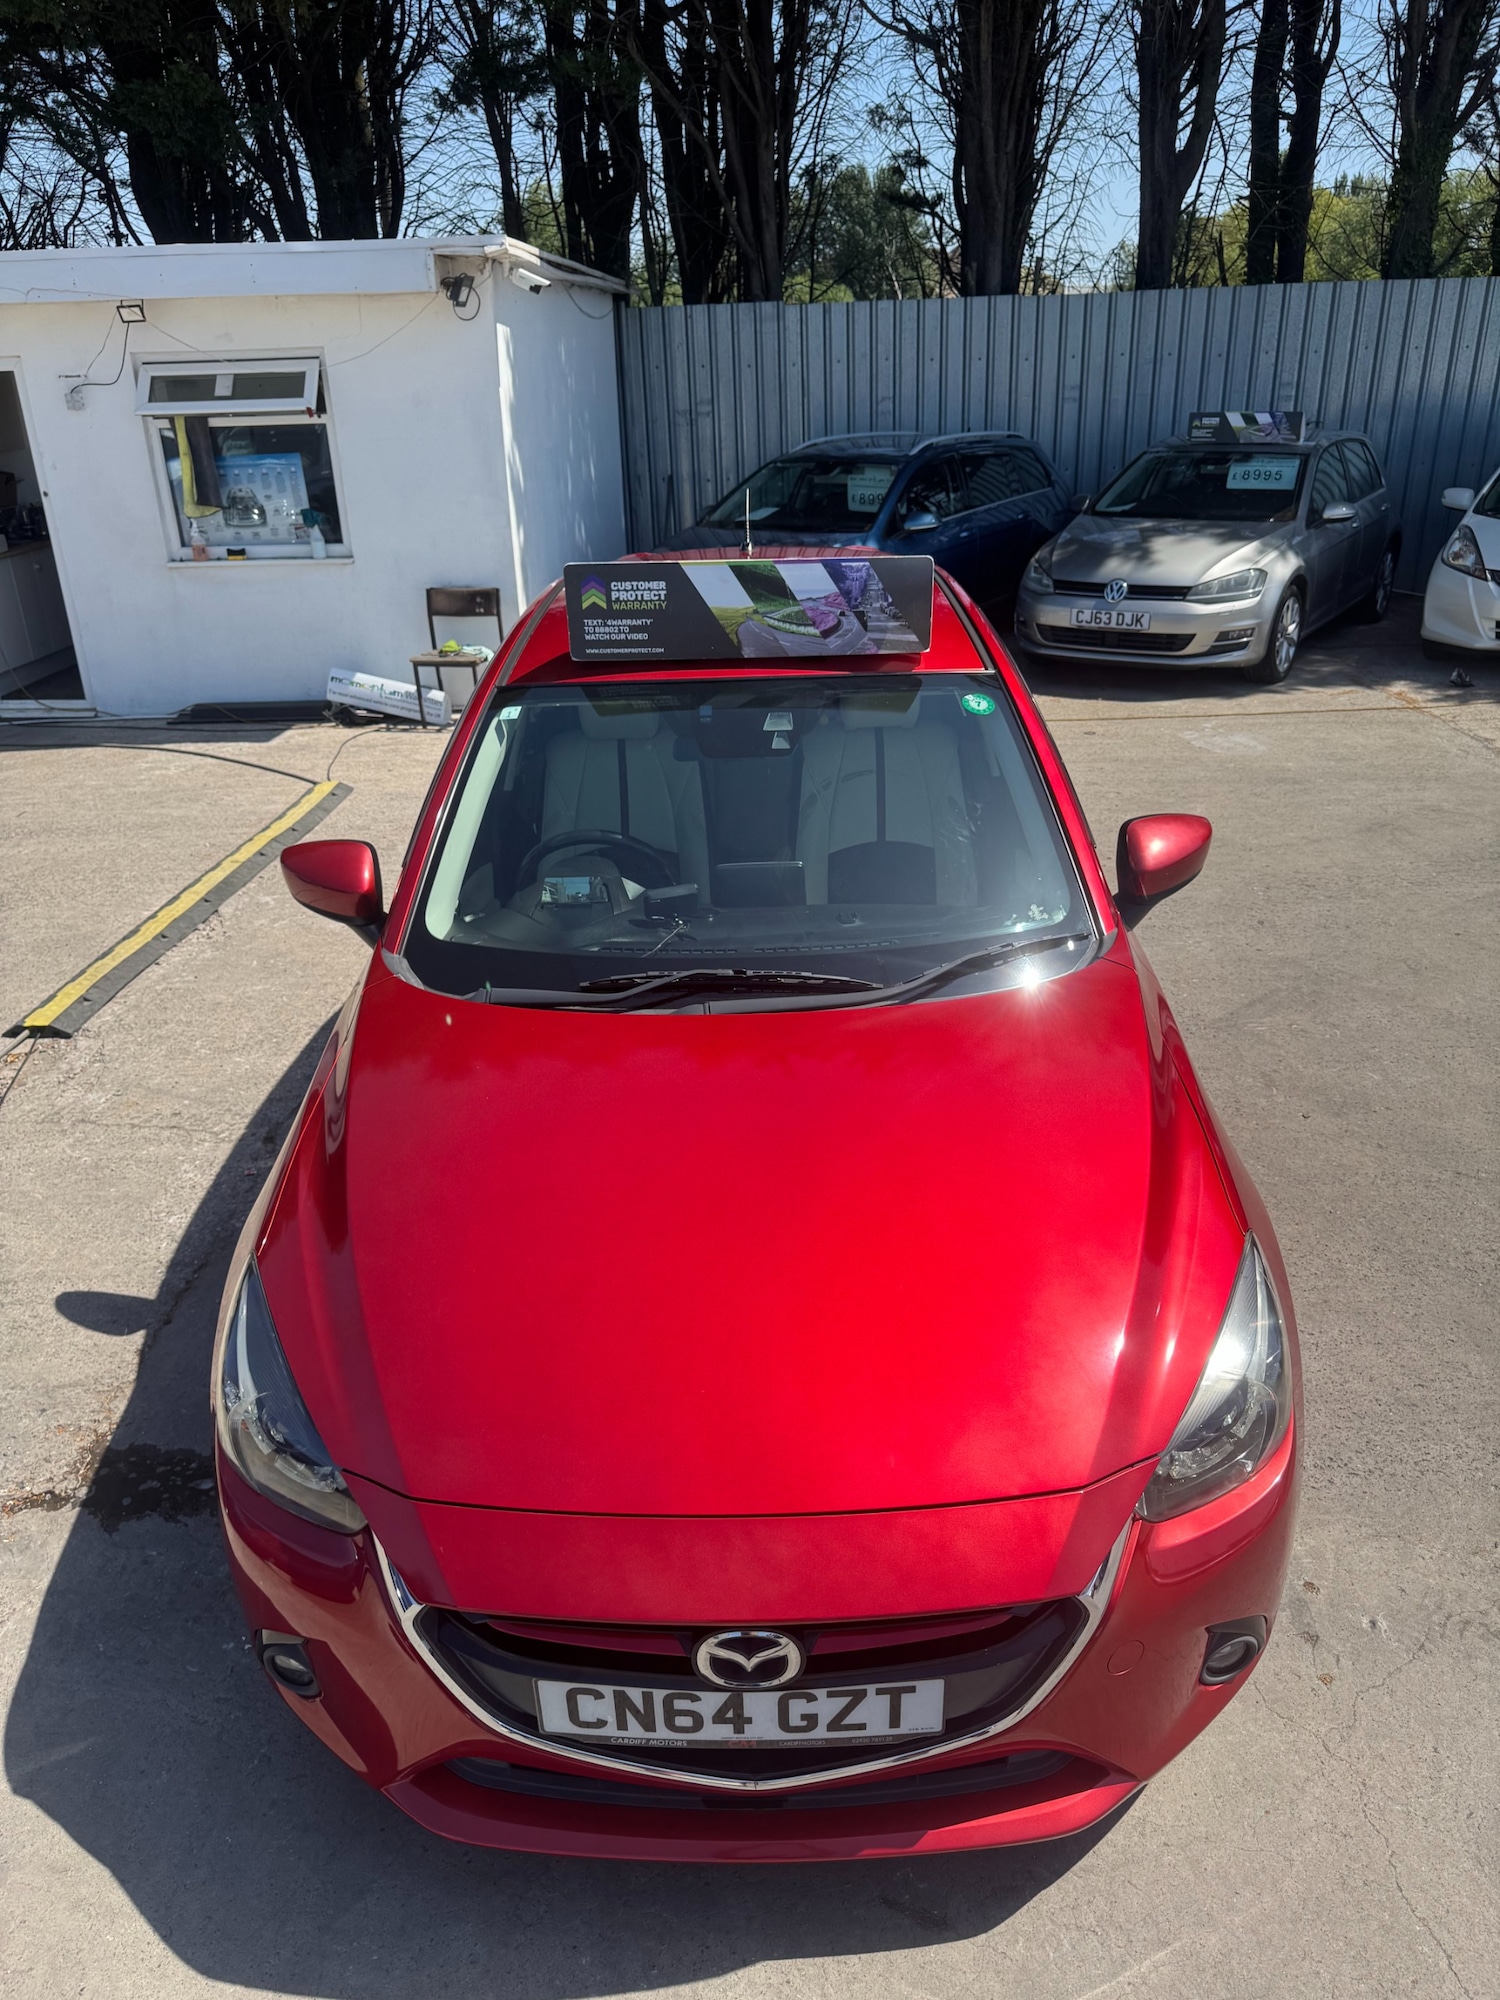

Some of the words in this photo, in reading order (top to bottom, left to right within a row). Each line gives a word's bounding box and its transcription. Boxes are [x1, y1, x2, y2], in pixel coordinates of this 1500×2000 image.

[611, 581, 666, 590] CUSTOMER
[611, 591, 667, 601] PROTECT
[612, 601, 667, 610] WARRANTY
[1075, 610, 1112, 626] CJ63
[1116, 613, 1145, 628] DJK
[610, 633, 627, 641] OUR
[565, 1687, 753, 1735] CN64
[777, 1685, 917, 1733] GZT
[611, 1737, 647, 1745] CARDIFF
[649, 1739, 688, 1747] MOTORS
